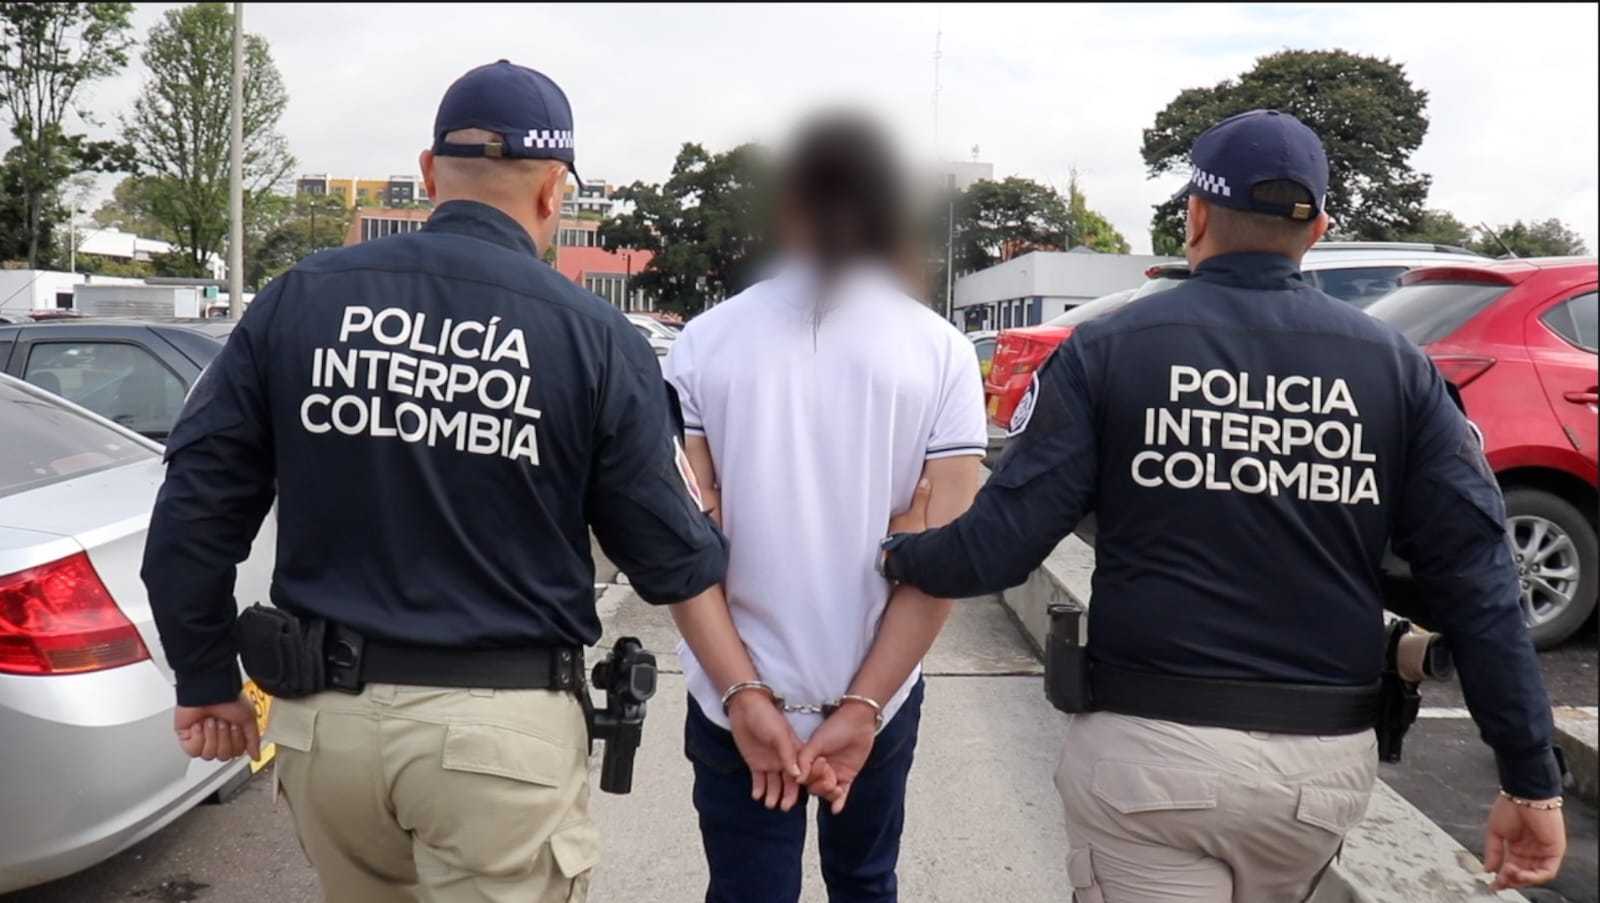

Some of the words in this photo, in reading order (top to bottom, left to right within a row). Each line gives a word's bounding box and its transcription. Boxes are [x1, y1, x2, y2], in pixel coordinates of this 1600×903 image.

[339, 305, 530, 369] POLICÍA
[312, 347, 542, 419] INTERPOL
[1170, 365, 1359, 417] POLICIA
[300, 394, 540, 466] COLOMBIA
[1145, 407, 1377, 462] INTERPOL
[1131, 450, 1380, 505] COLOMBIA
